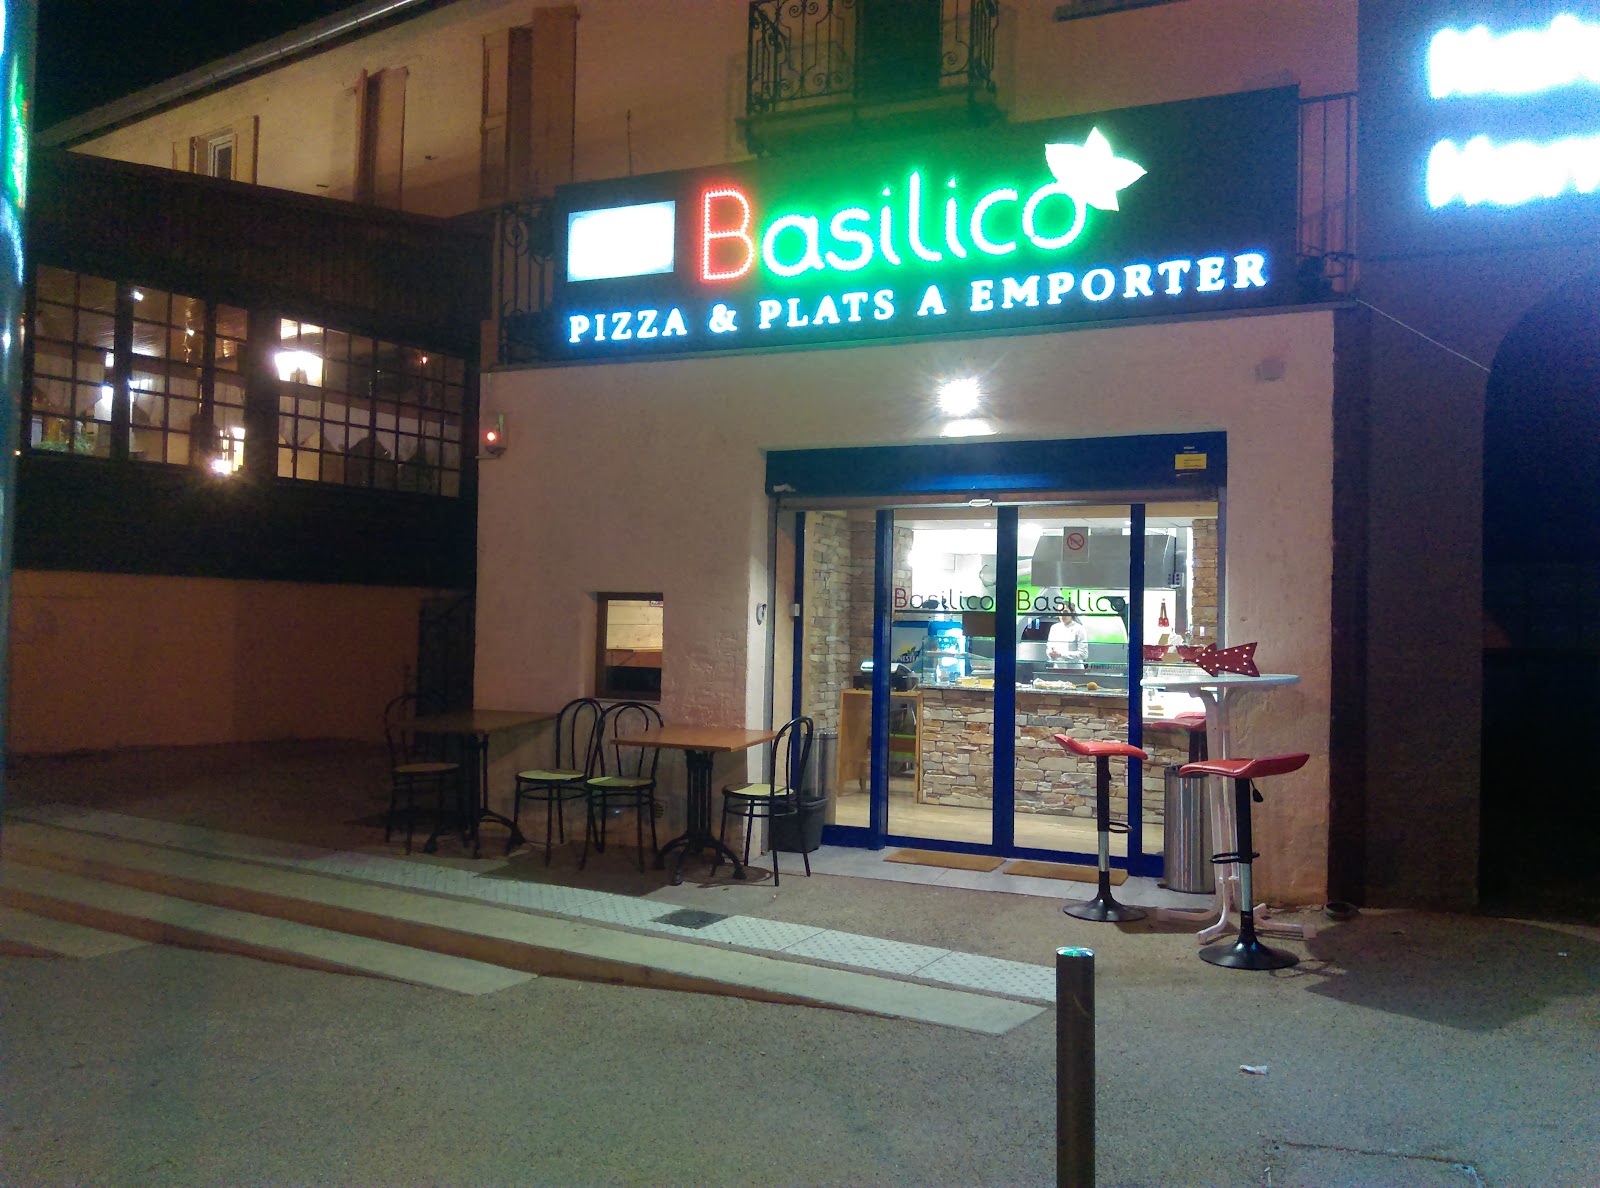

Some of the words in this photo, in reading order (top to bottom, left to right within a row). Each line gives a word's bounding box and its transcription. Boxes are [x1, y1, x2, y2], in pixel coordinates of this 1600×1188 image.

[702, 172, 1088, 281] Basilico
[568, 308, 690, 343] PIZZA
[709, 303, 738, 333] &
[758, 288, 897, 330] PLATS
[917, 285, 947, 316] A
[969, 252, 1267, 312] EMPORTER
[894, 587, 994, 610] Basilico
[1017, 589, 1126, 612] Basilico
